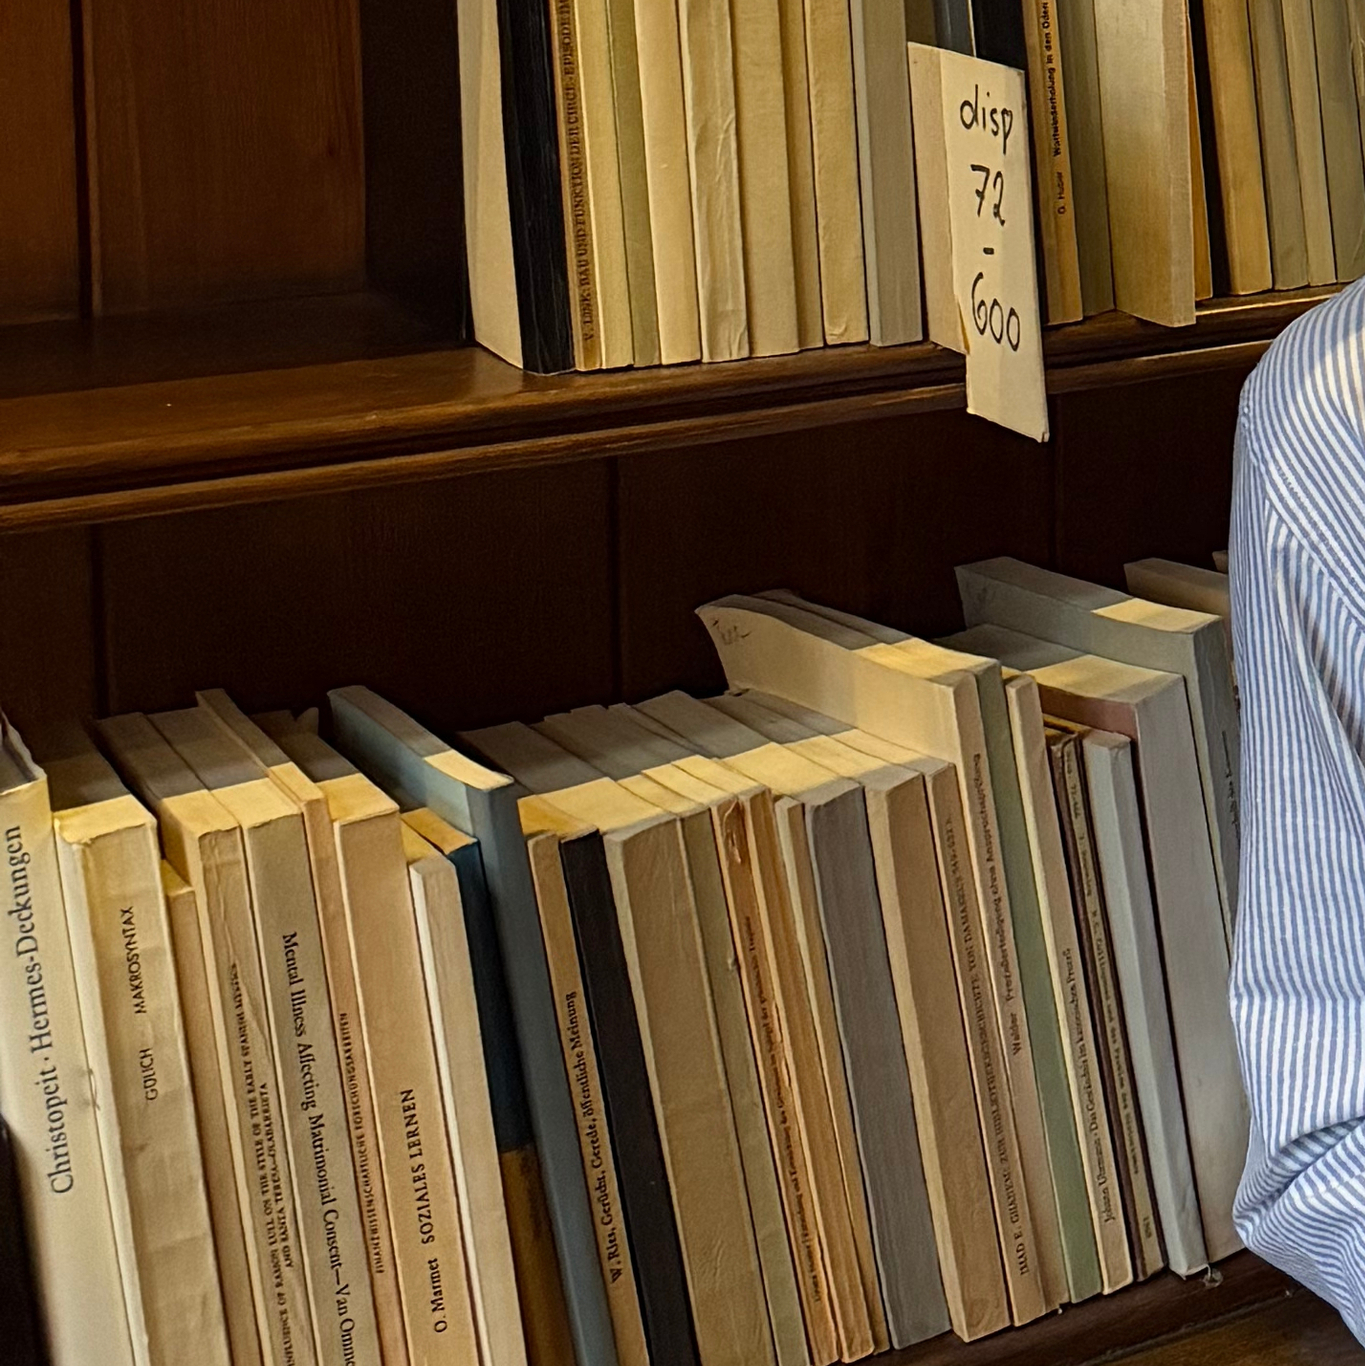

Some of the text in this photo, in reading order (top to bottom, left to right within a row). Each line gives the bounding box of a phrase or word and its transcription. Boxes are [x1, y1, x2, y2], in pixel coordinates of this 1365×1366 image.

[1039, 1, 1050, 28] Oden
[1042, 32, 1052, 51] den
[1044, 54, 1053, 64] in
[960, 84, 1013, 156] disp
[970, 164, 1005, 227] 72
[971, 272, 1021, 352] 600
[281, 931, 304, 985] Mental
[0, 824, 79, 1195] Christopeit Hermes-Deckungen
[118, 905, 159, 1101] GÜLICH MAKROSYNTAX
[289, 989, 311, 1037] Illness
[561, 991, 585, 1050] Meinung
[242, 1060, 255, 1093] EARLY
[292, 1041, 322, 1111] Affecting
[570, 1050, 595, 1117] öffentliche
[247, 1097, 259, 1119] THE
[251, 1122, 261, 1136] OF
[253, 1138, 266, 1170] STYLE
[307, 1113, 337, 1205] Matrimonial
[582, 1117, 604, 1169] Gerede,
[258, 1172, 270, 1195] THE
[262, 1198, 273, 1215] ON
[275, 1206, 289, 1242] SANTA
[399, 1088, 448, 1333] O. Marmet SOZIALES LERNEN
[265, 1217, 277, 1245] LULL
[281, 1244, 293, 1268] AND
[607, 1260, 624, 1283] W.
[276, 1291, 286, 1305] OF
[278, 1308, 295, 1366] INFLUENCE
